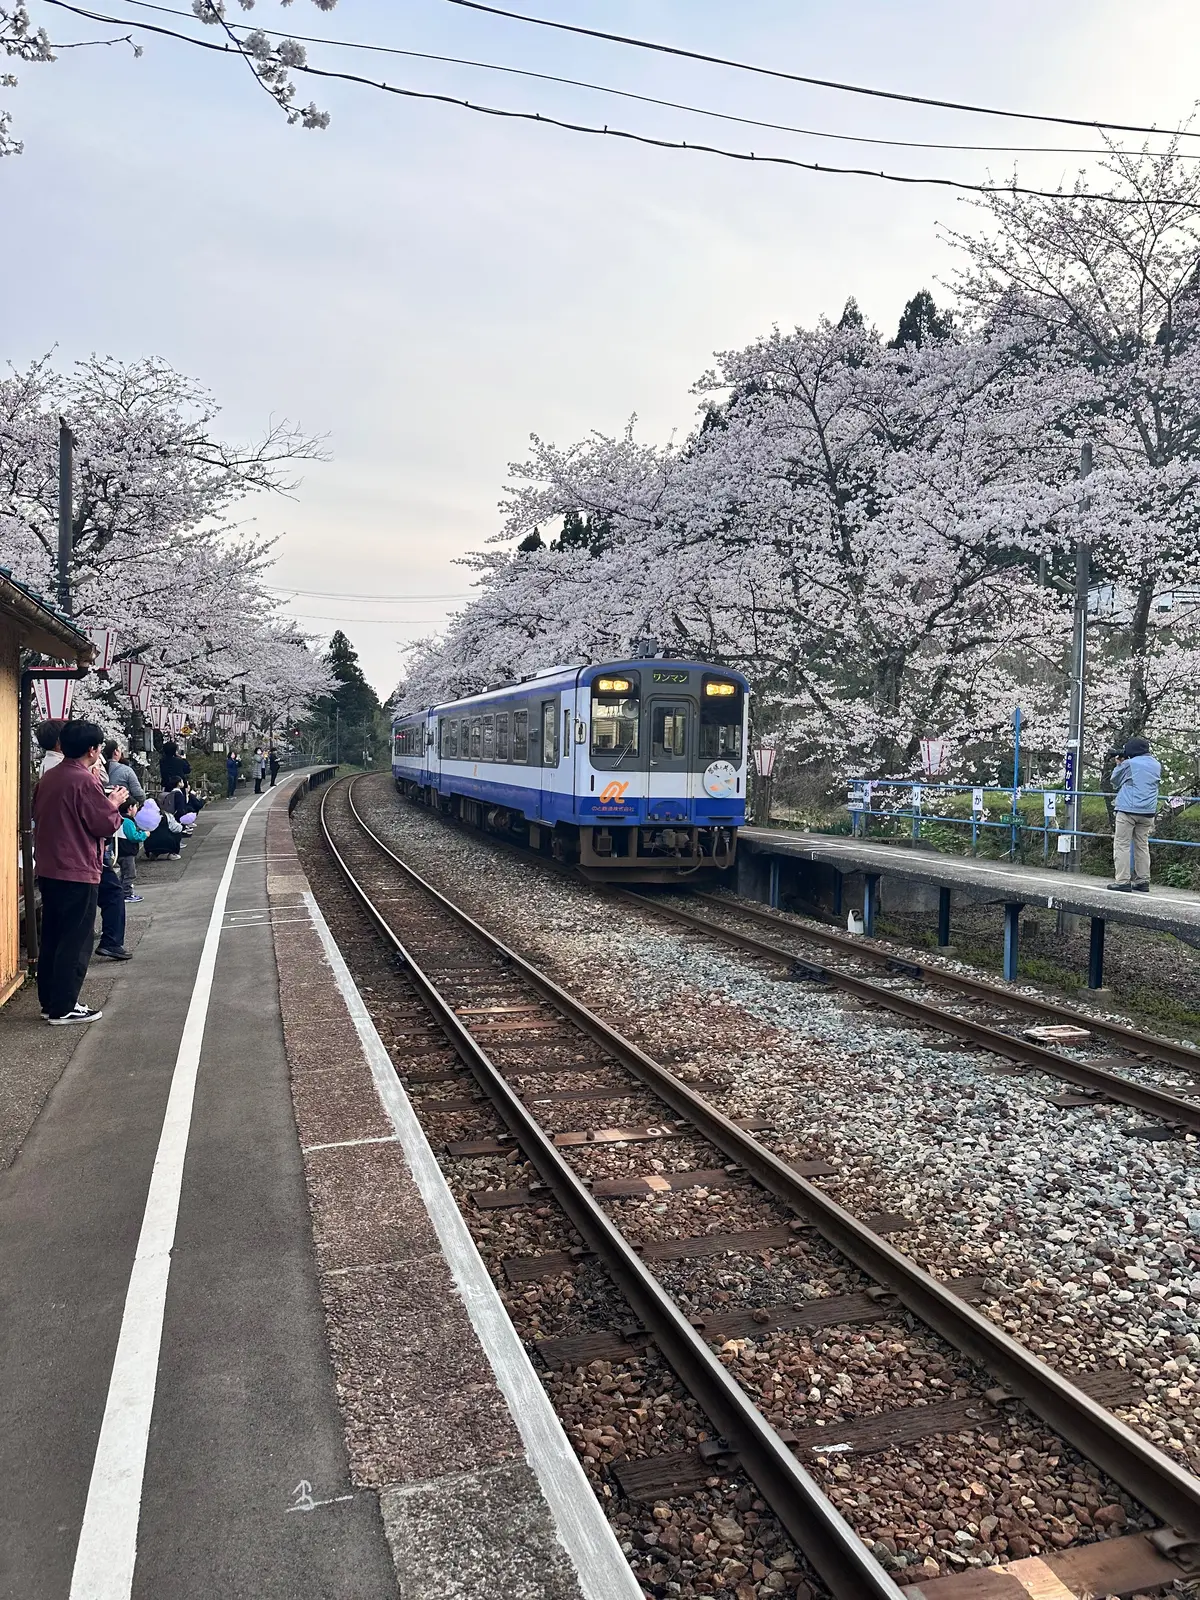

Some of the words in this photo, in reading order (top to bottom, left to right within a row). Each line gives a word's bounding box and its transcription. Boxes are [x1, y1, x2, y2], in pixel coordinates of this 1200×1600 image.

[653, 673, 688, 683] ワンマン
[1047, 798, 1054, 810] と
